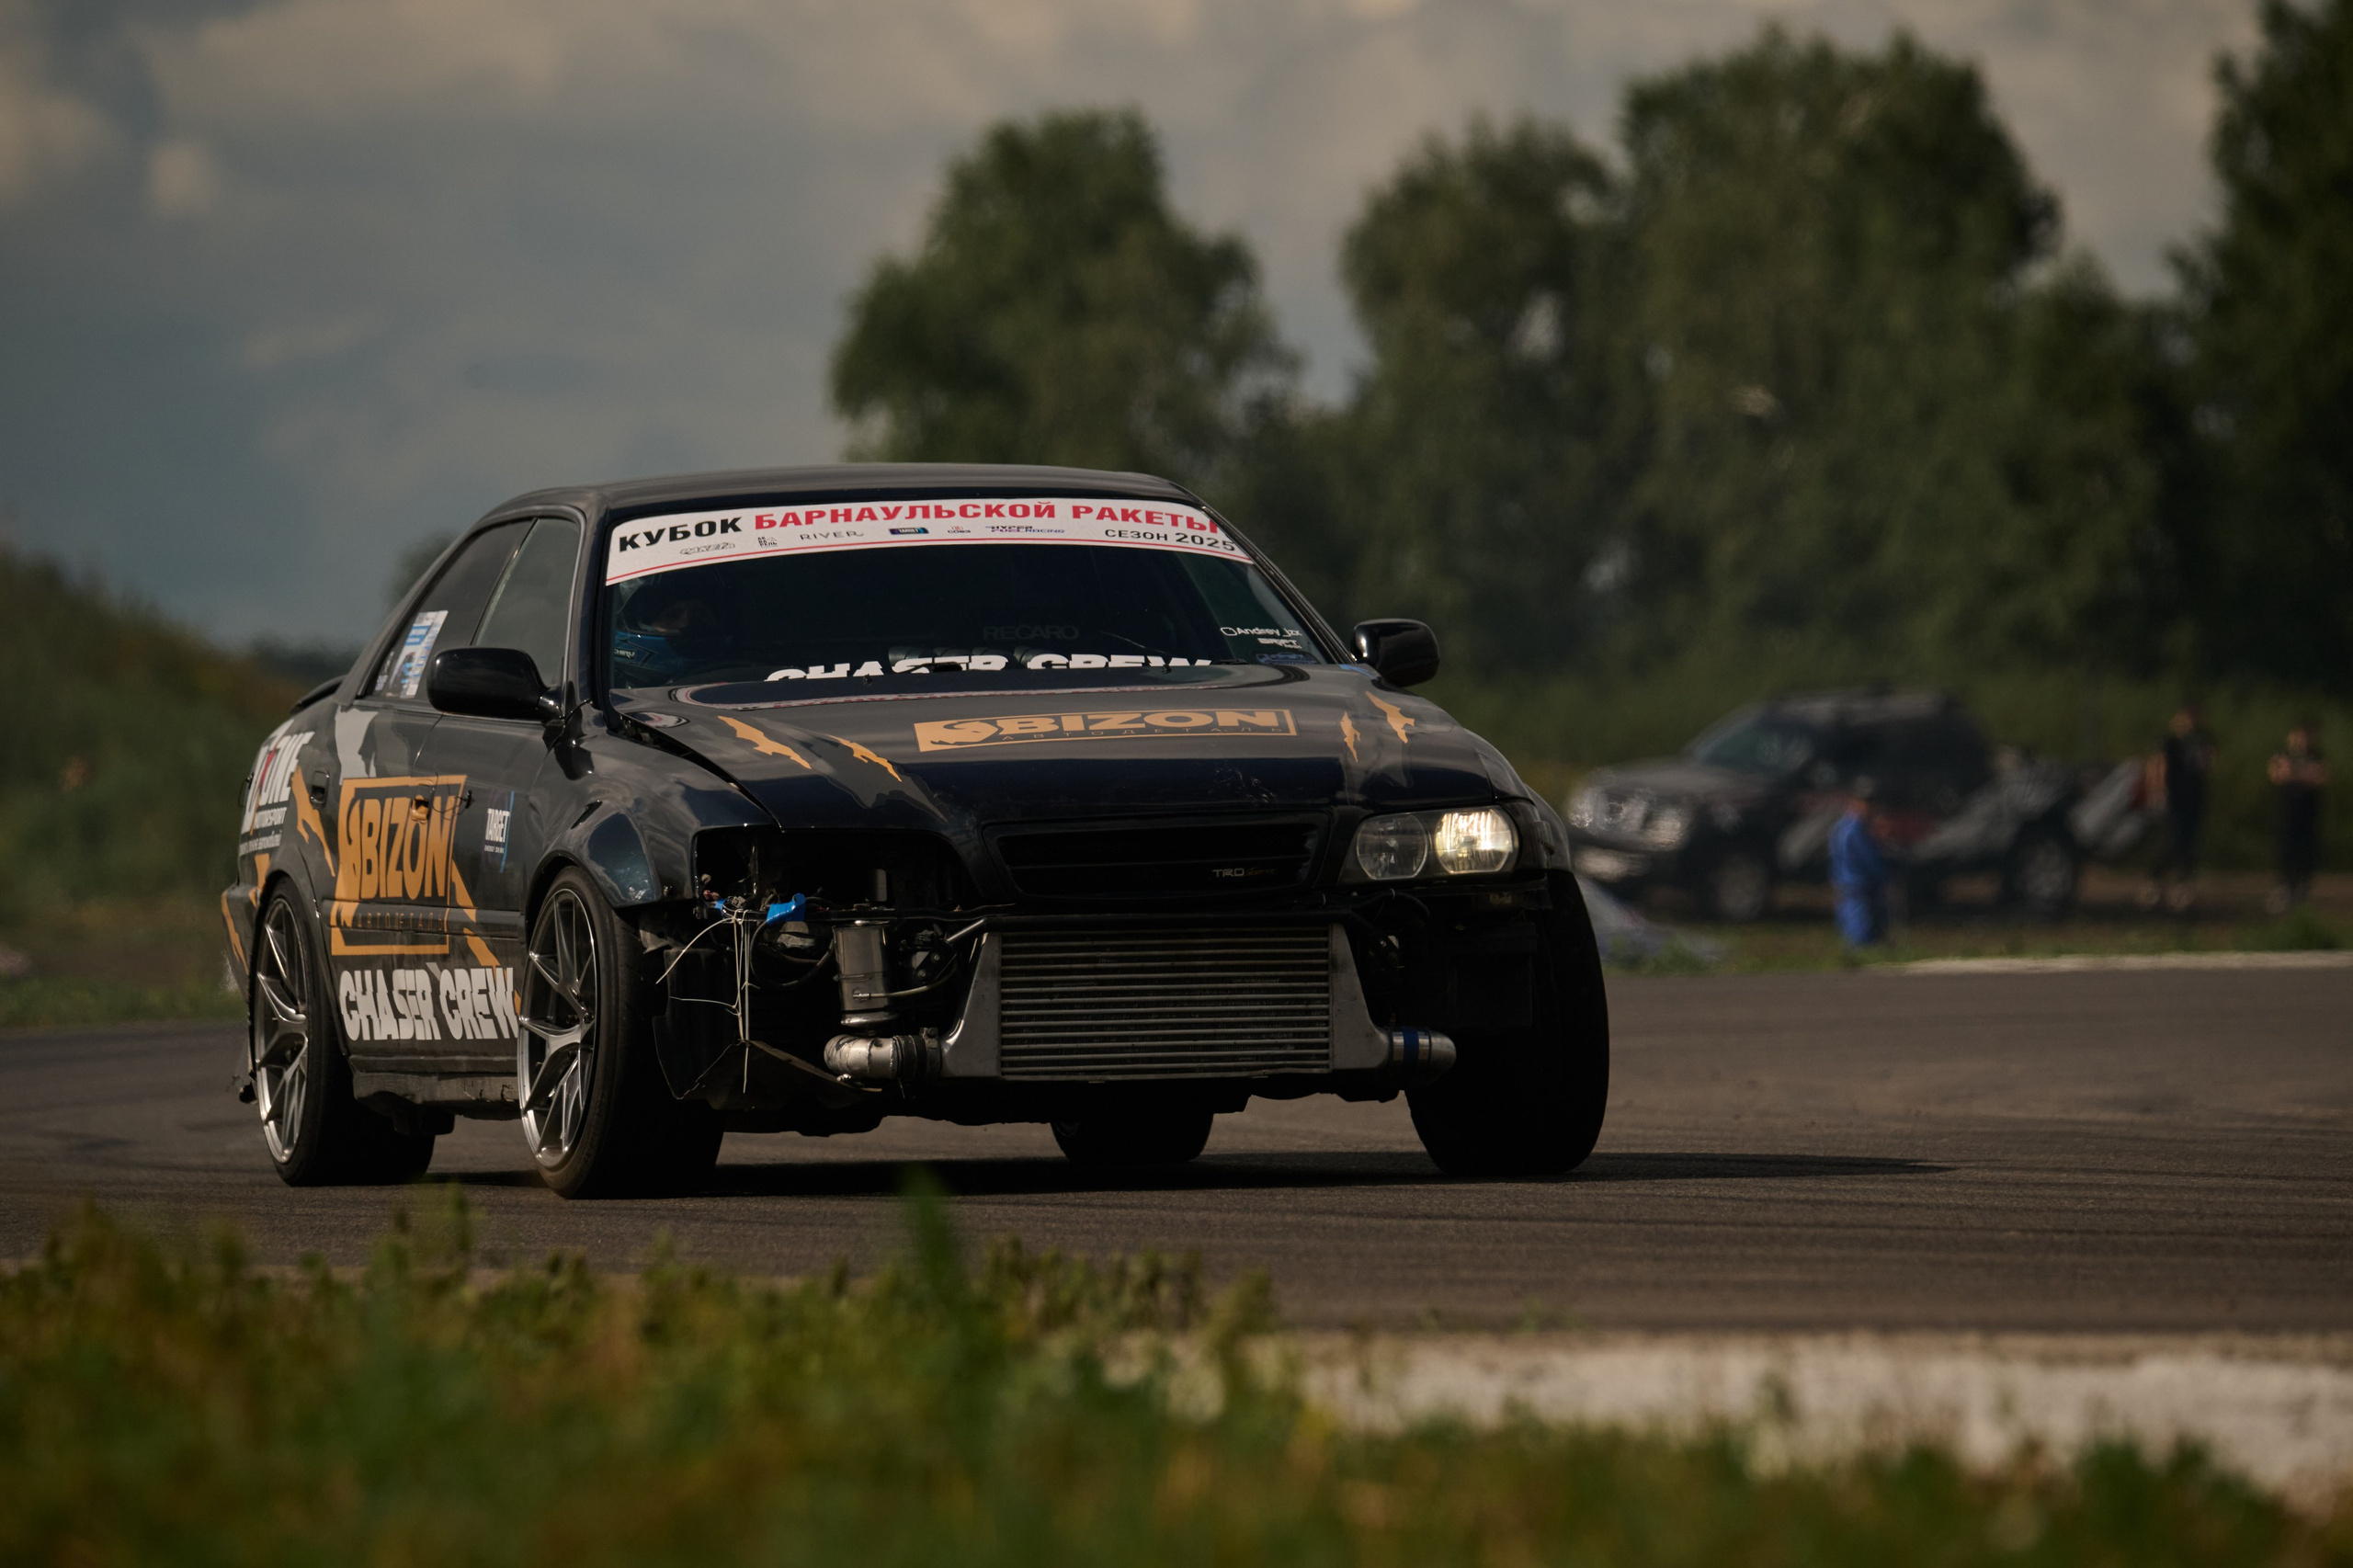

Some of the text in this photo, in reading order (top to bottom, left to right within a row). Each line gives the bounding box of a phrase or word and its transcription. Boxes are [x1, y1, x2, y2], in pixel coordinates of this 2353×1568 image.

[619, 501, 1221, 552] КУБОК БАРНАУЛЬСКОЙ РАКЕТЫ
[800, 530, 864, 540] RIVER
[1105, 528, 1236, 551] СЕЗОН 2025
[983, 624, 1080, 641] RECARO
[996, 710, 1279, 735] BIZON
[484, 807, 510, 843] TARGET
[359, 795, 457, 901] BIZON
[1211, 867, 1245, 878] TRD
[339, 967, 519, 1041] CHASER CREW
